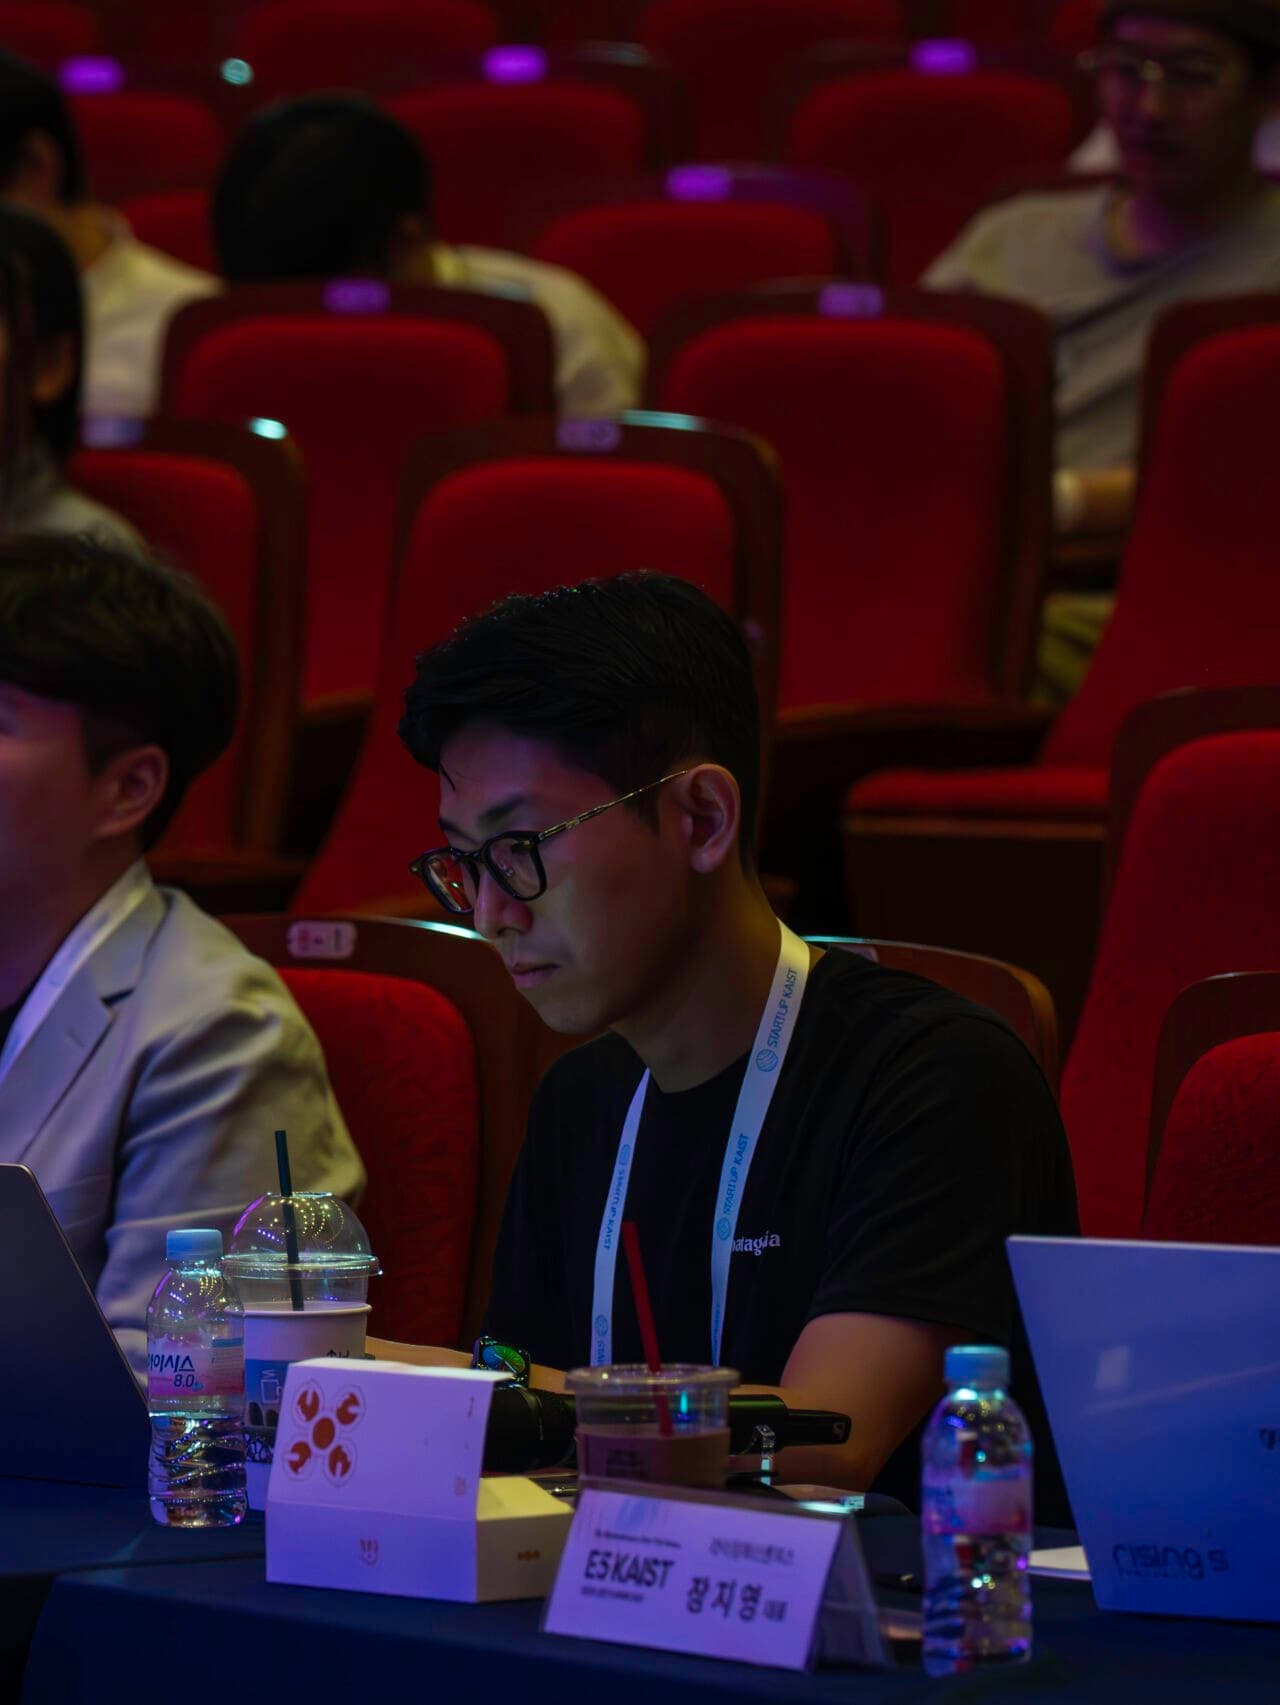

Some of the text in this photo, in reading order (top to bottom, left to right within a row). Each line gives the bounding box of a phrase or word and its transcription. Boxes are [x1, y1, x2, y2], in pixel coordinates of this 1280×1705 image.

[767, 968, 797, 1048] STARTUP KAIST
[723, 1133, 749, 1215] STARTUP KAIST
[173, 1374, 195, 1388] 8.0
